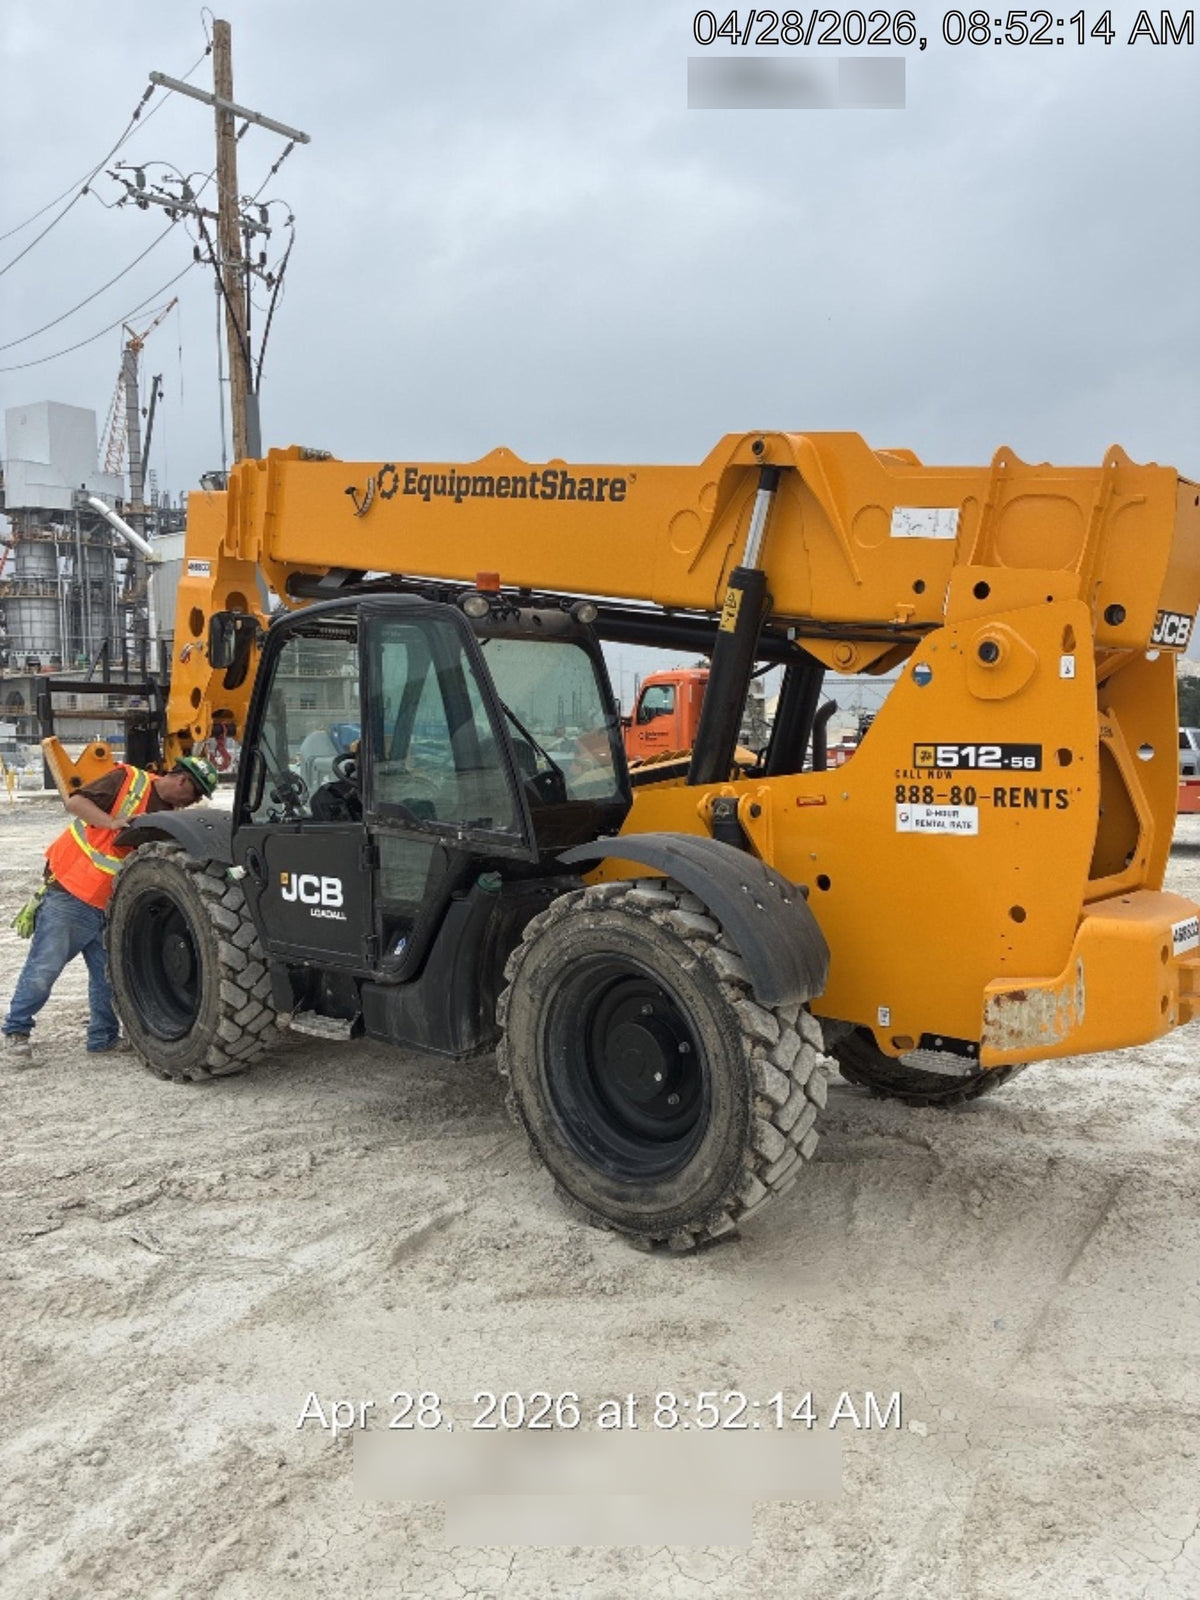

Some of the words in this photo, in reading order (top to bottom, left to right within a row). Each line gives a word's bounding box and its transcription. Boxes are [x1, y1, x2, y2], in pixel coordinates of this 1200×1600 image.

[402, 467, 628, 503] EquipmentShare
[1152, 614, 1191, 645] JCB
[895, 769, 922, 779] CALL
[927, 770, 953, 780] NOW
[894, 785, 1069, 809] 888-80-RENTS
[914, 819, 946, 829] RENTAL
[949, 820, 973, 830] RATE
[280, 873, 344, 907] JCB
